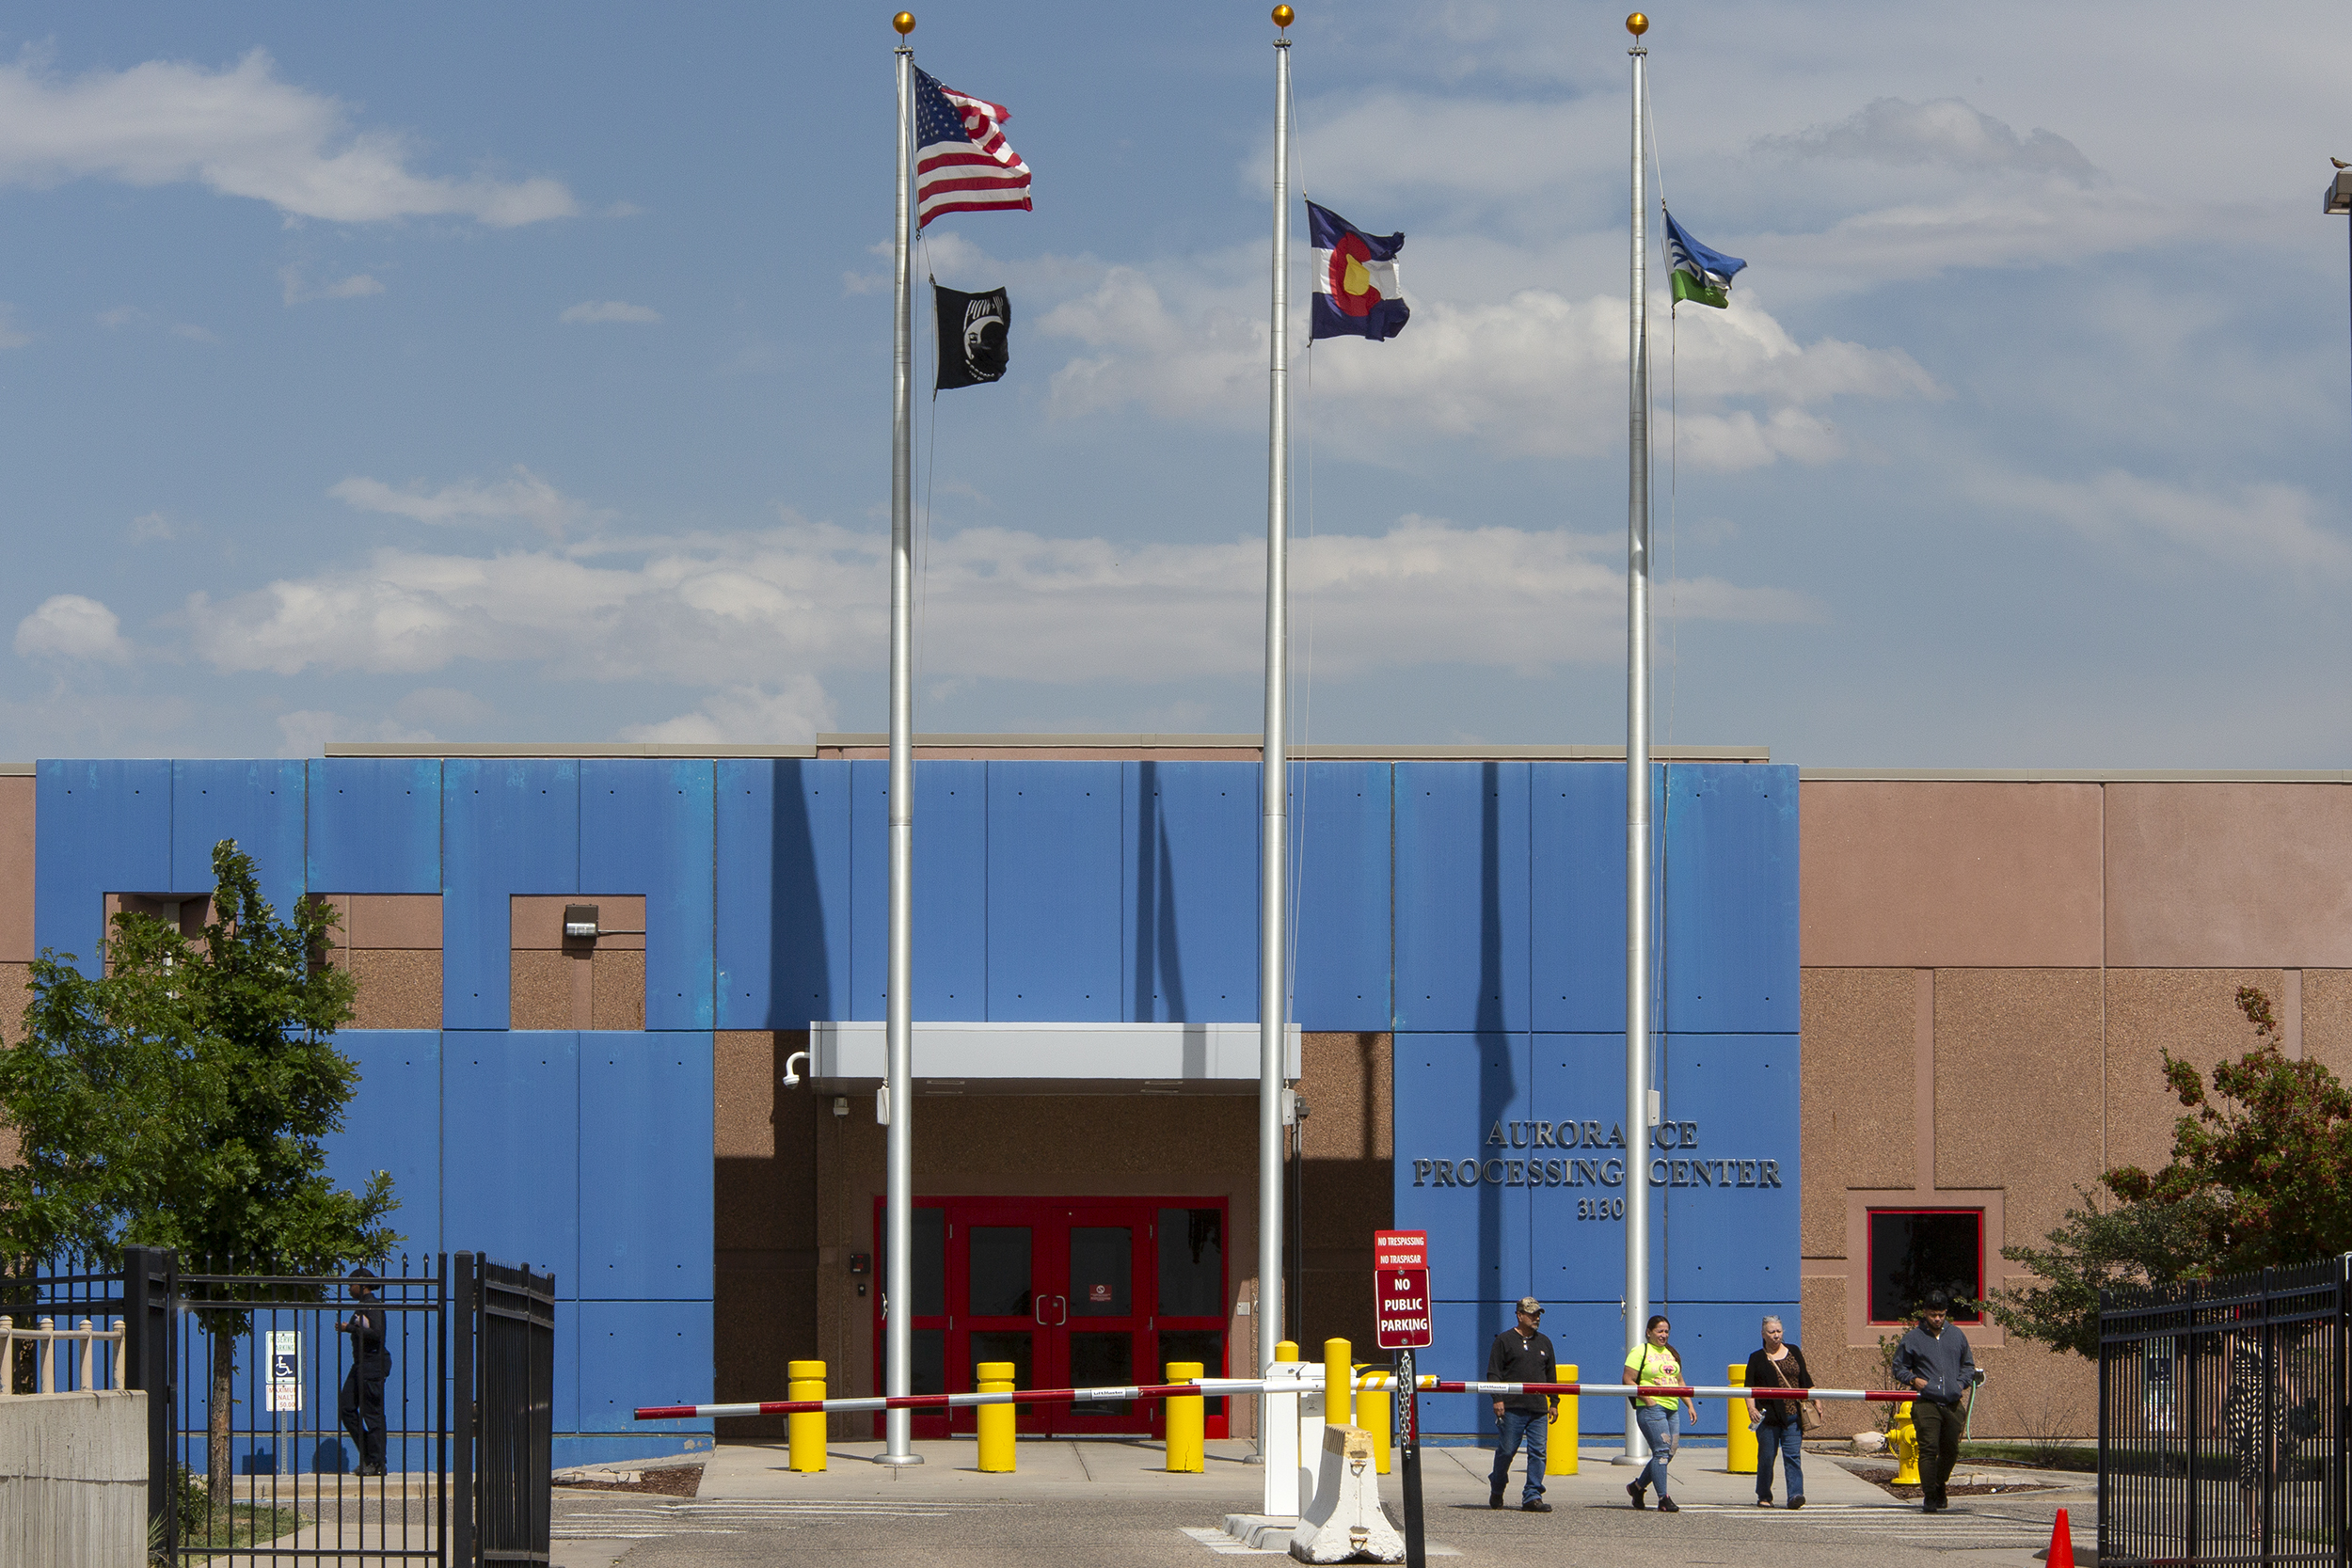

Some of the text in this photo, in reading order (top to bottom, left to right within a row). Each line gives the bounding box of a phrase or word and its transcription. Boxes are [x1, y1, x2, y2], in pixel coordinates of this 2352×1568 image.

[1486, 1119, 1626, 1148] AURORA
[1413, 1158, 1783, 1185] PROCESSING CENTER
[1578, 1196, 1625, 1218] 3130
[1377, 1236, 1424, 1246] NO TRESPASSING
[1380, 1254, 1422, 1264] NO TRASPASAR
[1394, 1278, 1410, 1291] NO
[1384, 1298, 1423, 1311] PUBLIC
[1381, 1318, 1428, 1332] PARKING
[270, 1335, 296, 1343] RSERVE
